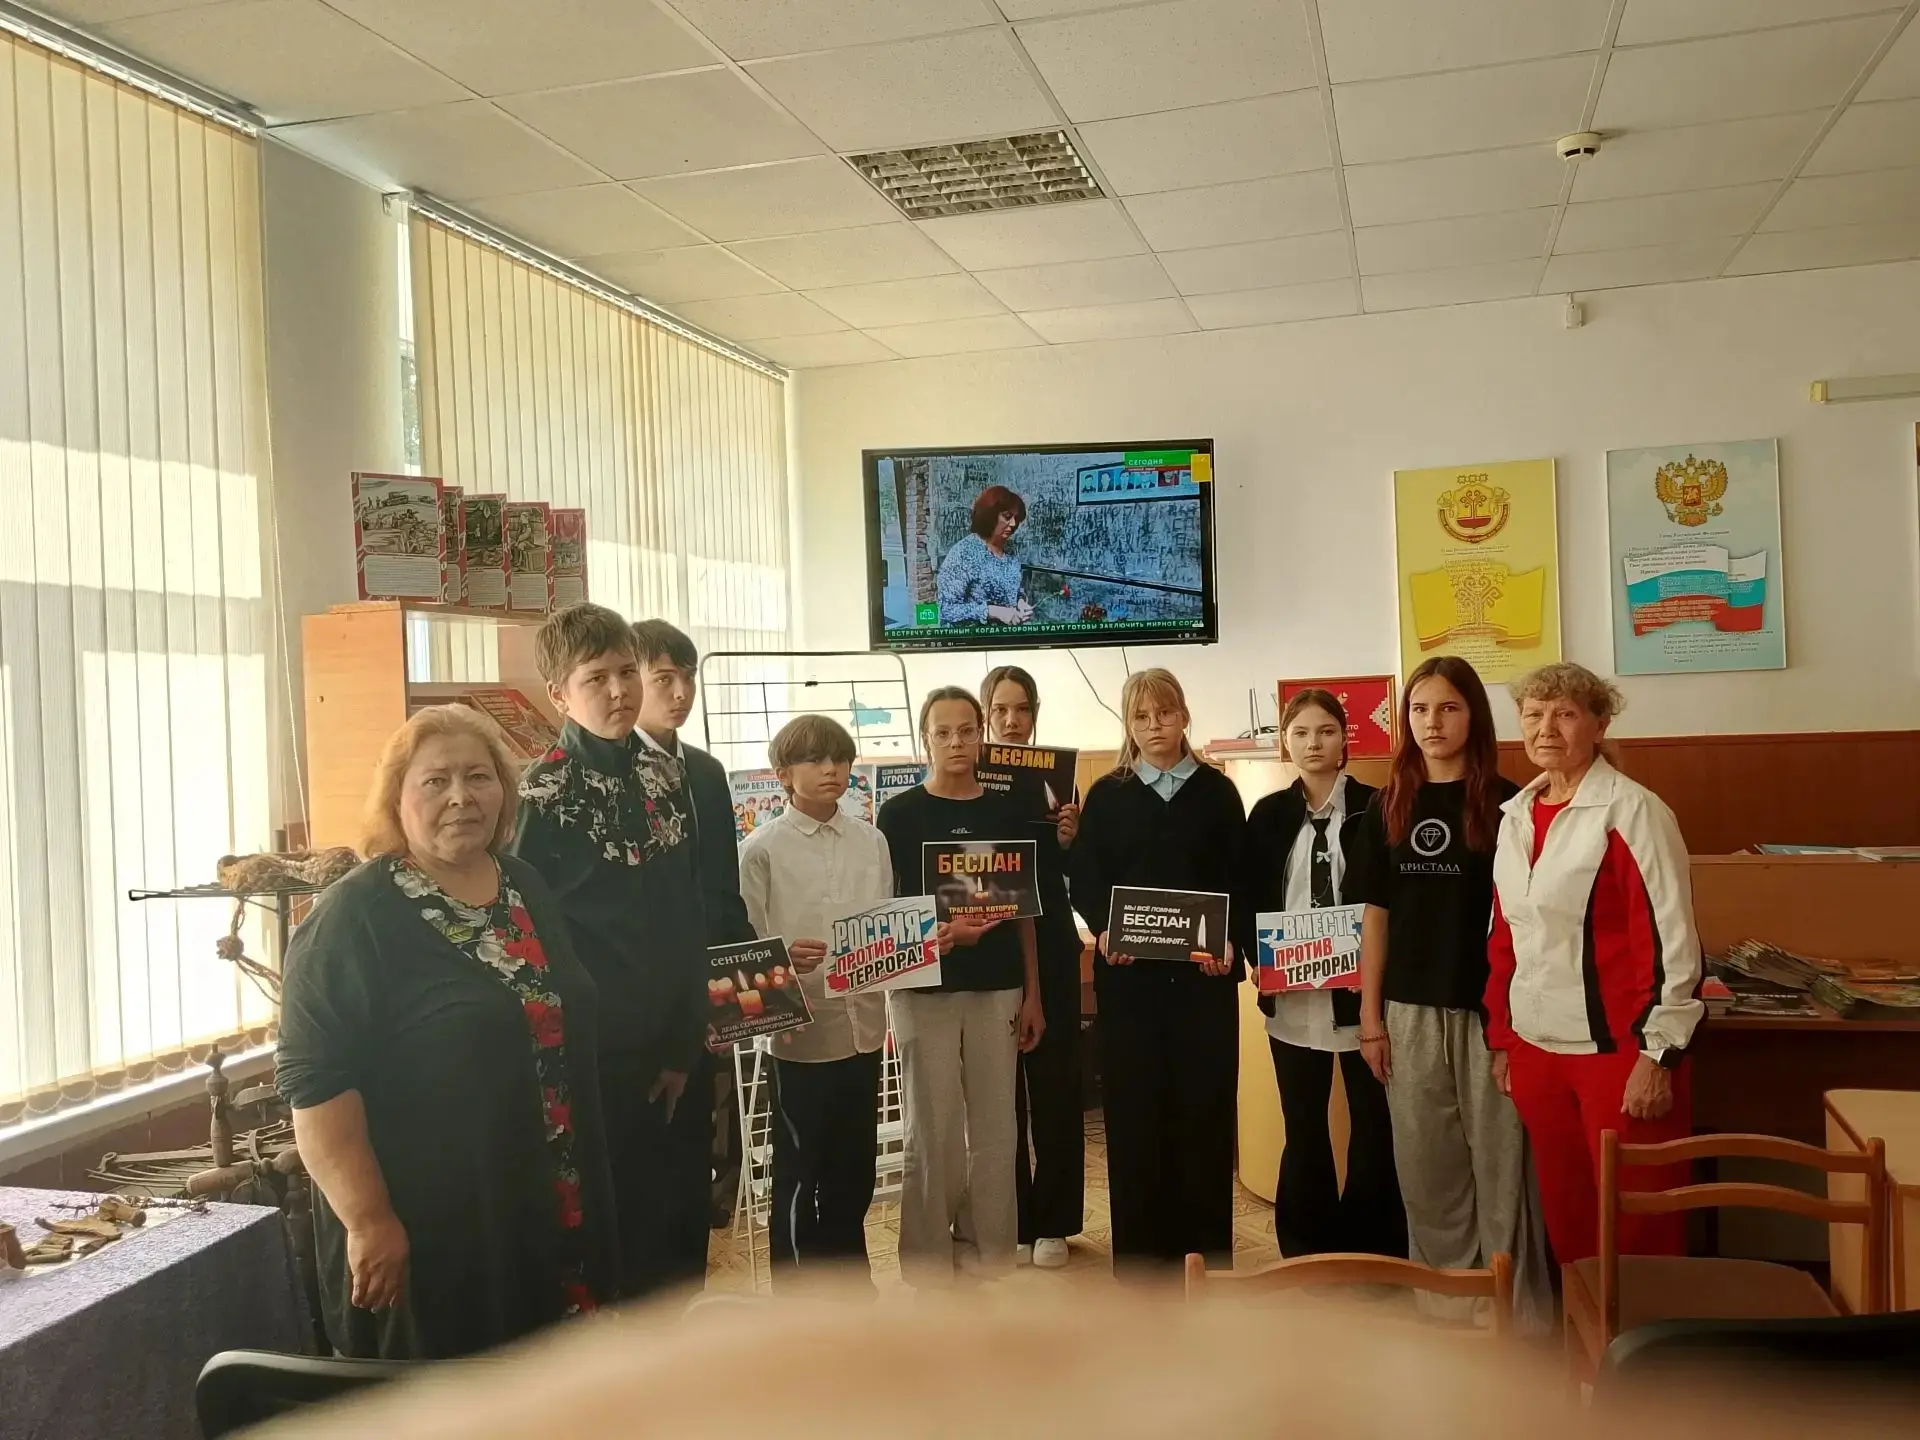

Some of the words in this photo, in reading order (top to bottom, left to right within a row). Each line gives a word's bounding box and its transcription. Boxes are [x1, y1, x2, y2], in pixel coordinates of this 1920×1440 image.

[1128, 458, 1164, 467] СЕГОДНЯ
[990, 747, 1056, 769] БЕСЛАН
[734, 782, 750, 791] МИР
[751, 781, 765, 789] БЕЗ
[881, 774, 916, 786] УГРОЗА
[938, 852, 1021, 874] БЕСЛАН
[1122, 913, 1191, 929] БЕСЛАН
[1282, 909, 1357, 940] ВМЕСТЕ
[833, 910, 922, 956] РОССИЯ
[1120, 934, 1149, 943] ЛЮДИ
[710, 948, 773, 966] сентября
[837, 937, 895, 976] ПРОТИВ
[1275, 937, 1333, 968] ПРОТИВ
[847, 944, 924, 989] ТЕРРОРА!
[1286, 952, 1355, 985] ТЕРРОРА!
